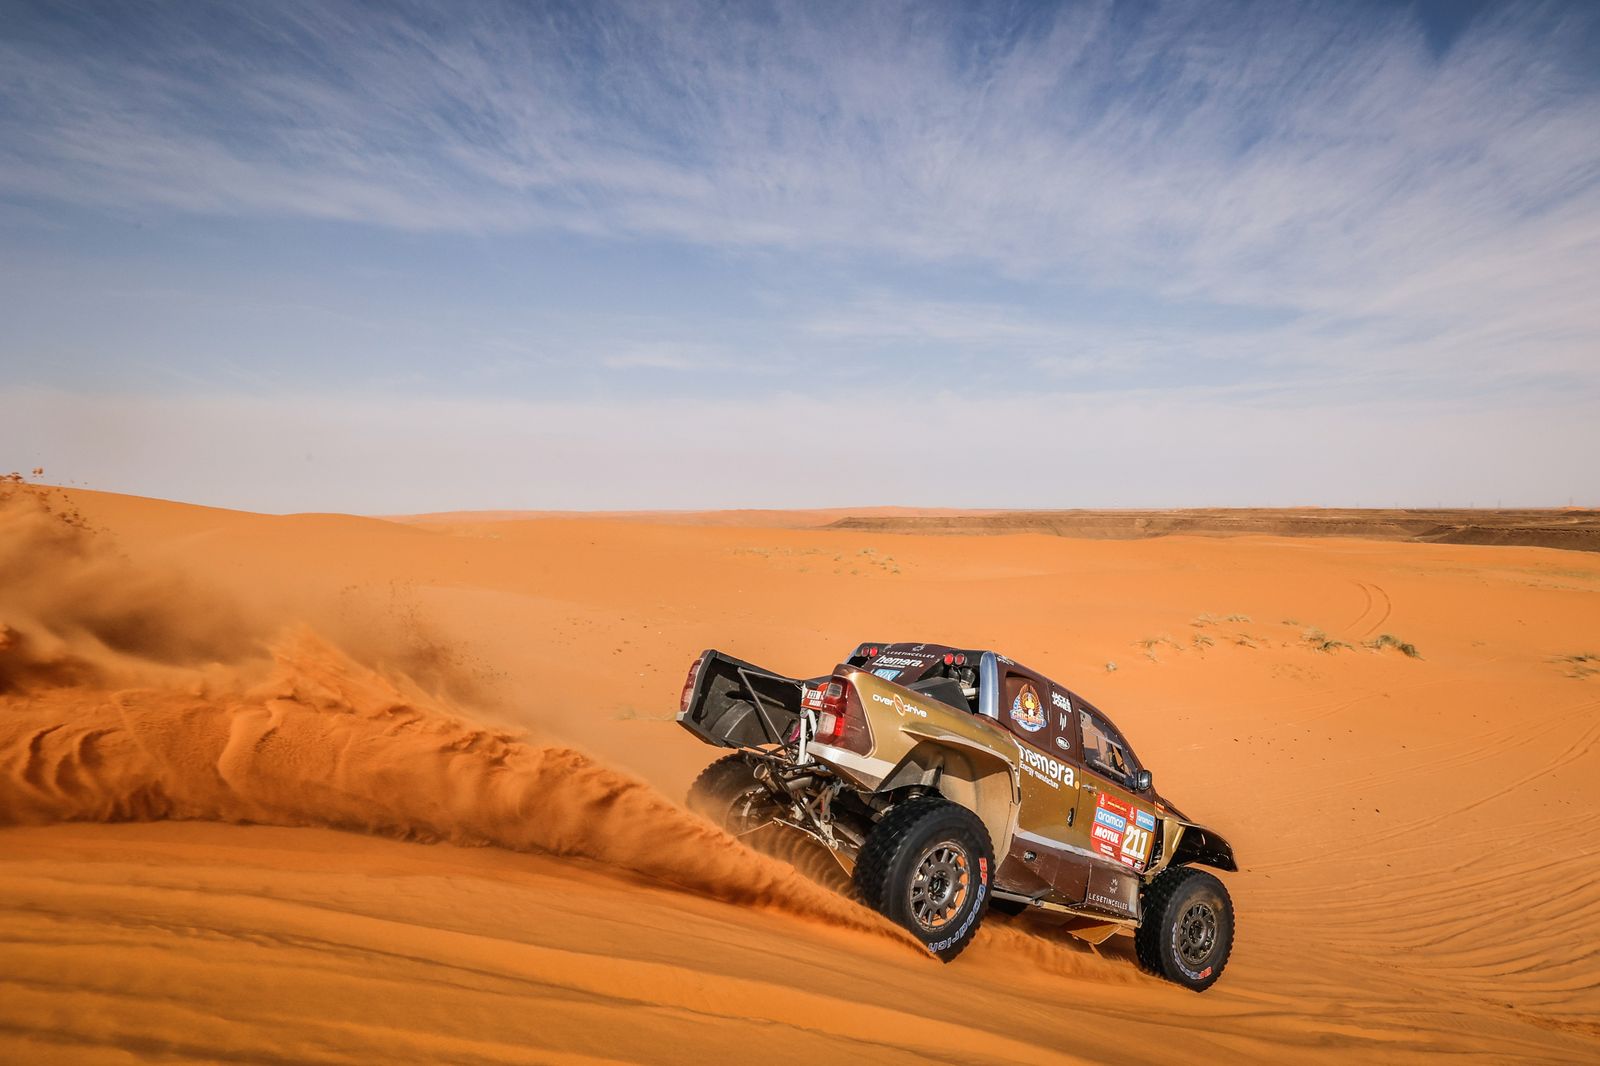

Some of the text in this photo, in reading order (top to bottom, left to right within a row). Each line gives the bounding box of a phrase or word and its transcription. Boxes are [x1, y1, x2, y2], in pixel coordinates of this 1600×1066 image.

[872, 693, 928, 718] over drive
[1097, 811, 1124, 829] aramco
[1094, 826, 1120, 844] MOTUL
[1121, 825, 1148, 860] 211
[1088, 893, 1129, 911] LESETINCELLES
